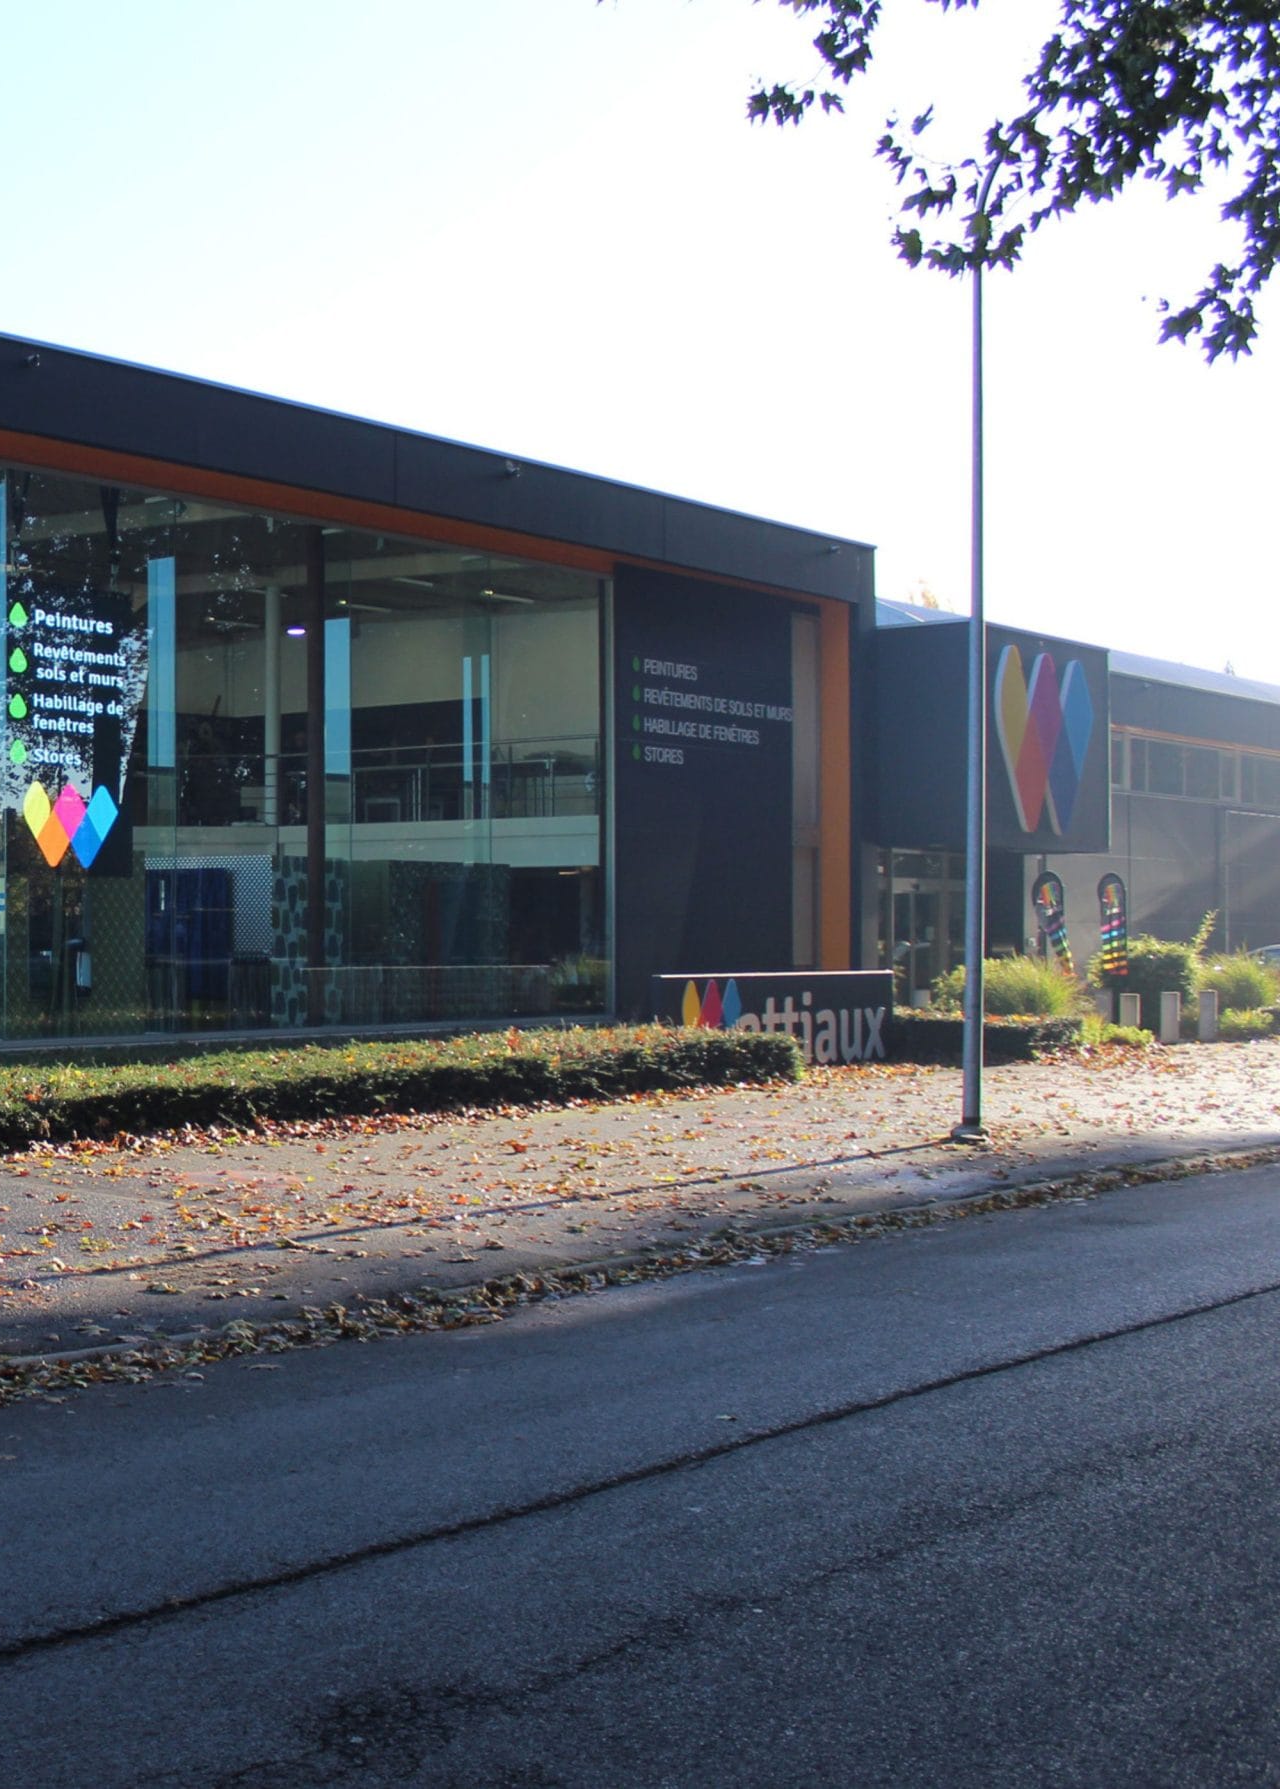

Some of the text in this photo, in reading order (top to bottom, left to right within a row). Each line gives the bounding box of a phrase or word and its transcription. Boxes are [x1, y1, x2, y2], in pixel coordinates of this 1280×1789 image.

[34, 609, 113, 634] Peintures
[33, 642, 126, 667] Revêtements
[36, 666, 124, 688] sols et murs
[644, 658, 698, 681] PEINTURES
[33, 693, 124, 716] Habillage de
[644, 686, 793, 722] REVÊTEMENTS DE SOLS ET MURS
[32, 714, 94, 734] fenêtres
[644, 717, 759, 745] HABILLAGE DE FENÊTRES
[33, 748, 82, 766] Stores
[644, 746, 684, 765] STORES
